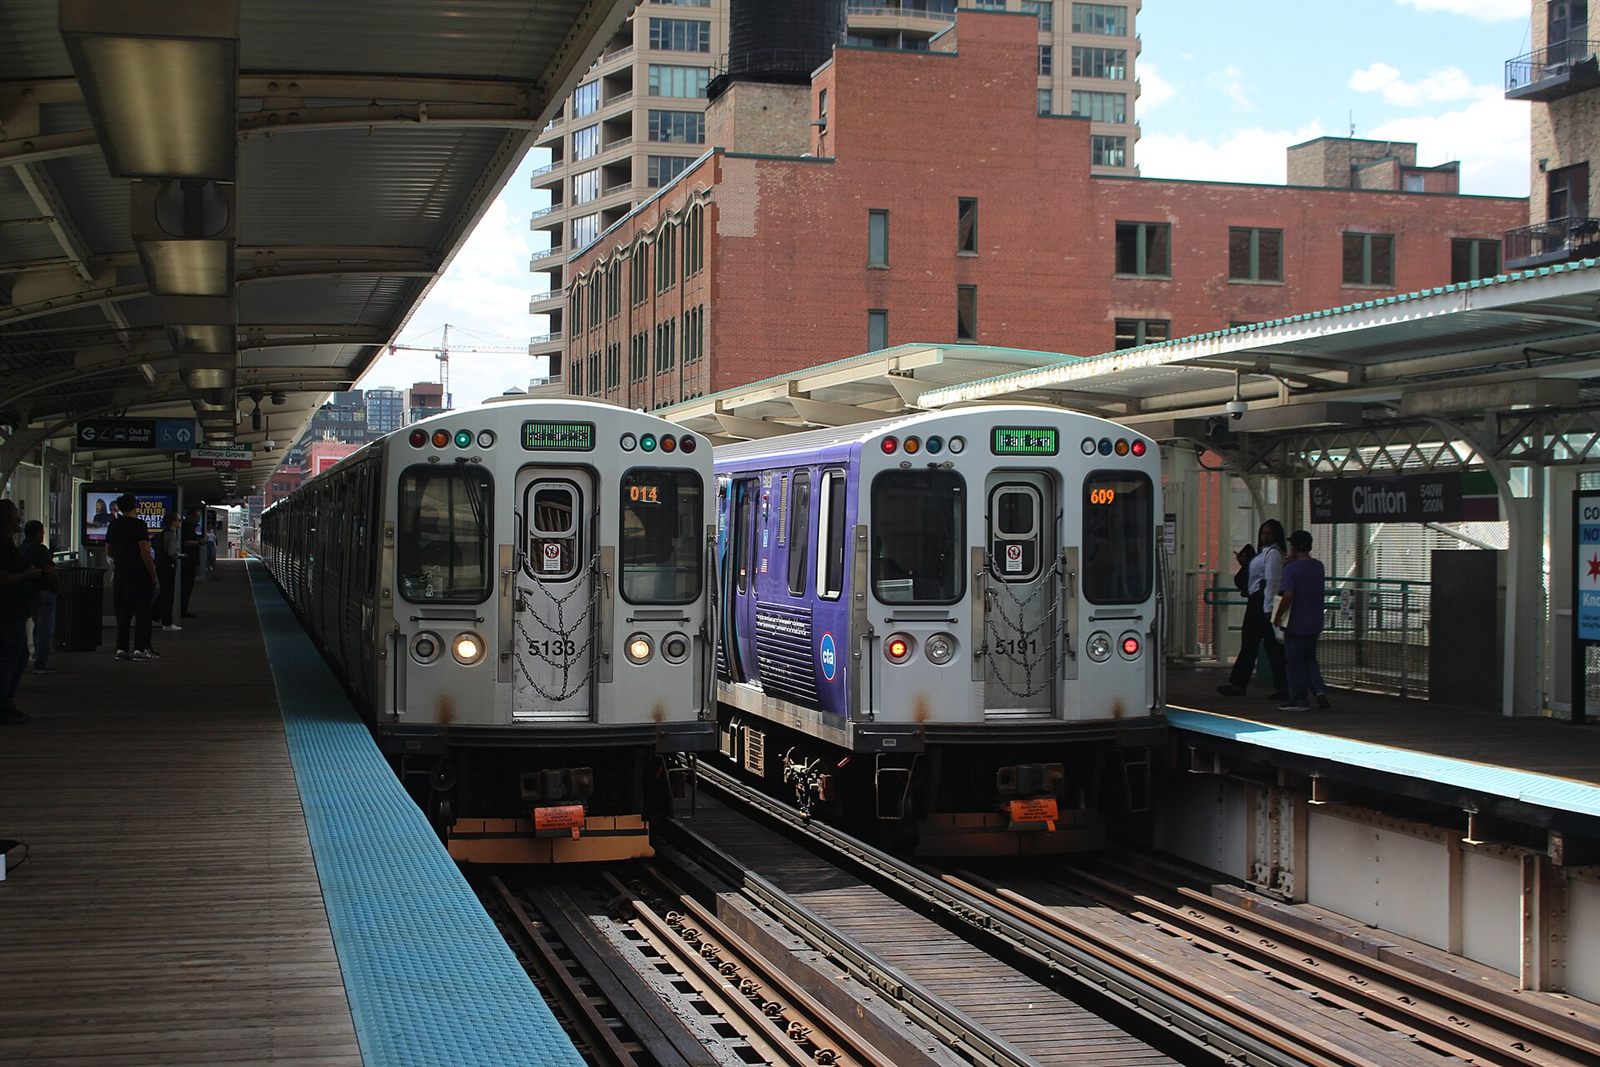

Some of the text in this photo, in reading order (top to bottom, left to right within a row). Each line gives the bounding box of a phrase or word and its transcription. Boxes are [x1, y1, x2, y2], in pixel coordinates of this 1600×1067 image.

[128, 427, 151, 435] Out to
[197, 450, 224, 458] Cottage
[212, 460, 230, 468] Loop
[630, 485, 658, 501] 014
[1090, 489, 1114, 504] 609
[1352, 486, 1407, 514] Clinton
[139, 501, 163, 509] YOUR
[528, 640, 575, 656] 5133
[995, 639, 1037, 655] 5191
[822, 648, 834, 665] cta
